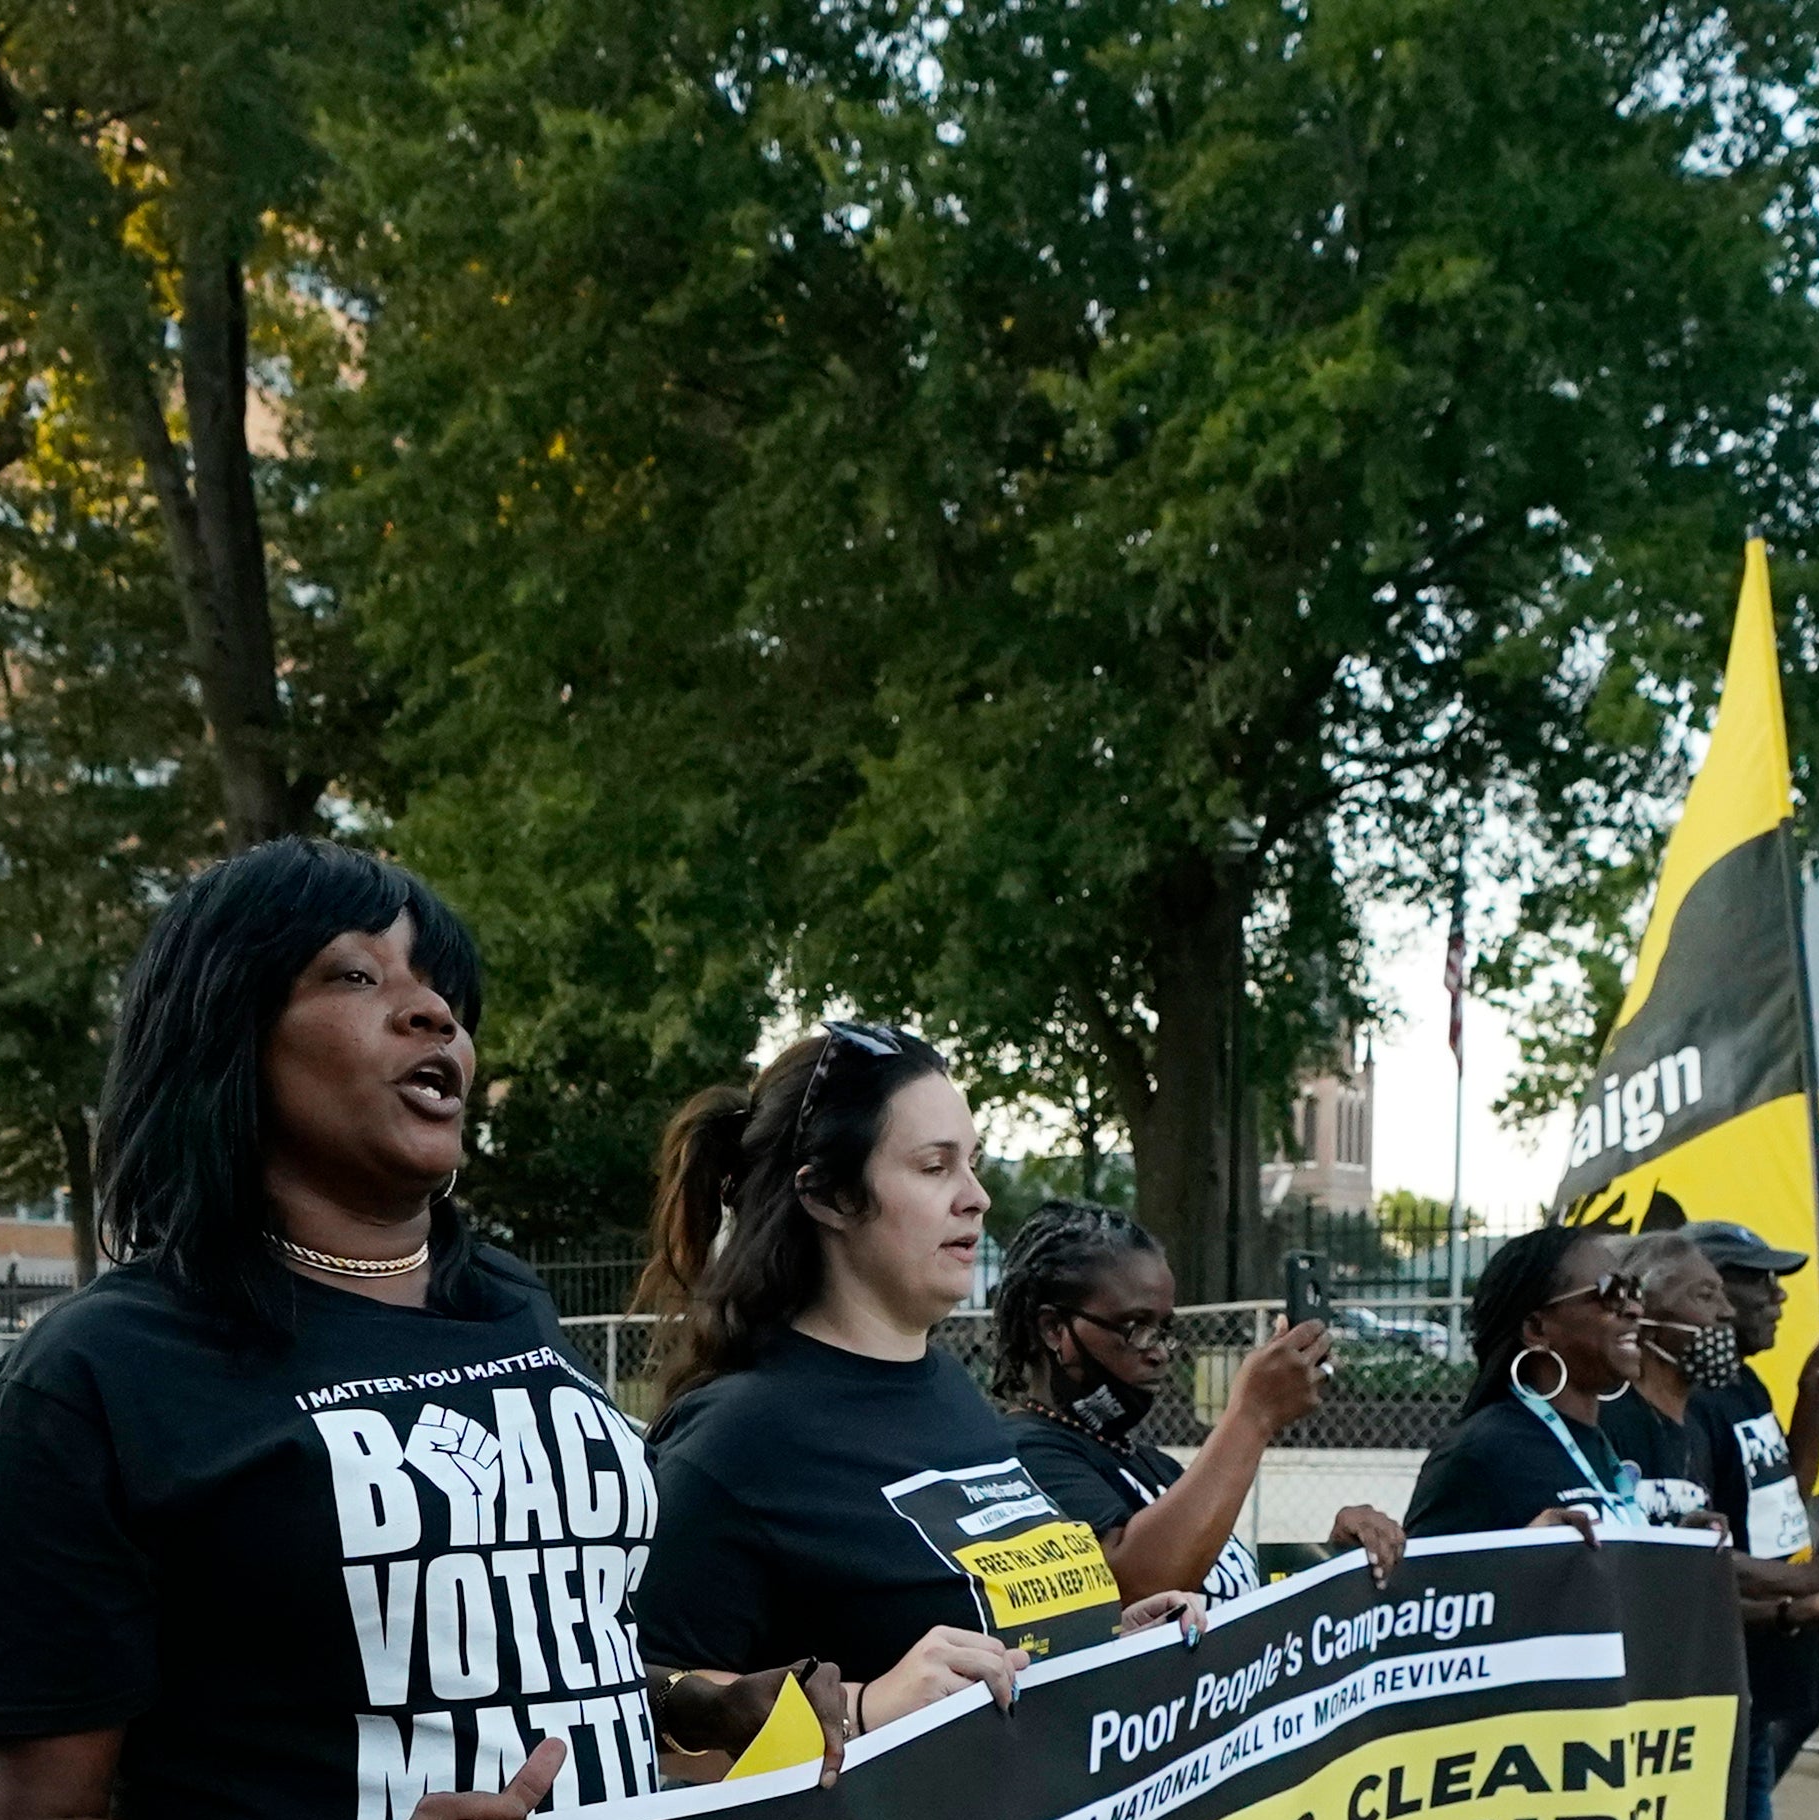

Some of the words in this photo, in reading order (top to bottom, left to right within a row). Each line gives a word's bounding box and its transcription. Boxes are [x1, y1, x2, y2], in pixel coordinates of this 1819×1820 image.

[295, 1393, 308, 1412] I
[411, 1366, 463, 1391] YOU
[973, 1552, 1016, 1578] FREE
[1005, 1549, 1033, 1570] THE
[1029, 1538, 1075, 1563] LAND,
[1004, 1577, 1051, 1610] WATER
[1045, 1575, 1058, 1600] &
[1054, 1567, 1085, 1598] KEEP
[1082, 1565, 1096, 1592] IT
[1088, 1697, 1186, 1775] Poor
[1189, 1628, 1304, 1732] People's
[1310, 1588, 1495, 1668] Campaign
[1218, 1729, 1265, 1773] CALL
[1272, 1710, 1306, 1748] for
[1314, 1677, 1369, 1728] MORAL
[1373, 1653, 1492, 1697] REVIVAL
[1630, 1725, 1697, 1778] HE
